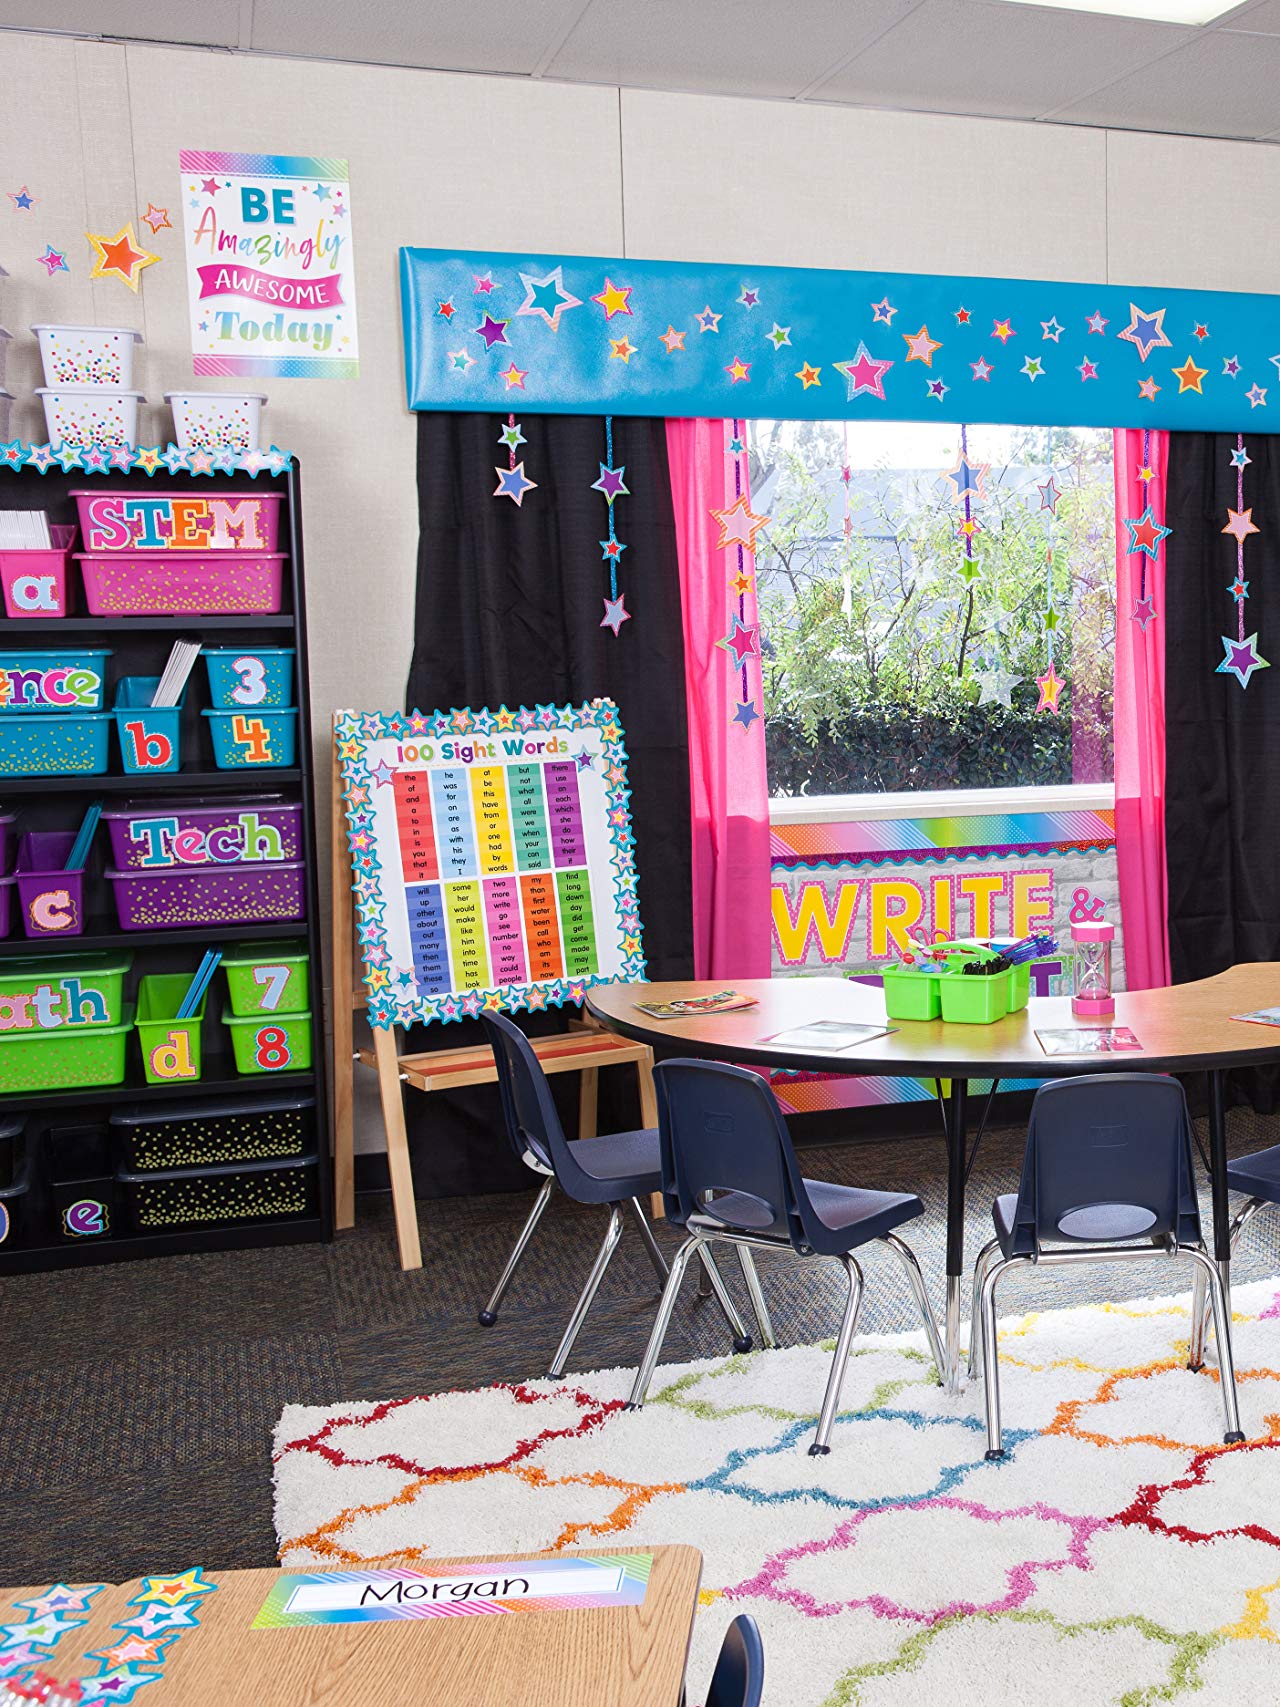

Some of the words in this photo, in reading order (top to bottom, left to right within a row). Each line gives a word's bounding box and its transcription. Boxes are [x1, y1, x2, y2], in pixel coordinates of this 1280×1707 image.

[241, 187, 297, 225] BE
[193, 206, 345, 272] Amazingly
[213, 267, 330, 305] AWESOME
[214, 311, 334, 352] Today
[90, 498, 263, 551] STEM
[13, 574, 57, 611] a
[231, 656, 266, 704] 3
[126, 721, 172, 767] b
[232, 715, 271, 762] 4
[397, 744, 434, 762] 100
[441, 740, 496, 763] Sight
[502, 736, 569, 756] Words
[554, 805, 574, 813] which
[130, 813, 284, 867] Tech
[487, 864, 508, 872] words
[31, 890, 72, 929] c
[417, 887, 430, 895] will
[453, 904, 475, 913] would
[493, 901, 511, 909] write
[416, 909, 436, 918] other
[416, 919, 438, 928] about
[771, 868, 1054, 966] WRITE
[1068, 887, 1106, 924] &
[492, 933, 519, 942] number
[252, 965, 291, 1010] 7
[465, 980, 481, 989] look
[498, 974, 522, 985] people
[150, 1030, 196, 1078] d
[255, 1024, 292, 1070] 8
[66, 1200, 104, 1234] e
[359, 1574, 530, 1606] Morgan
